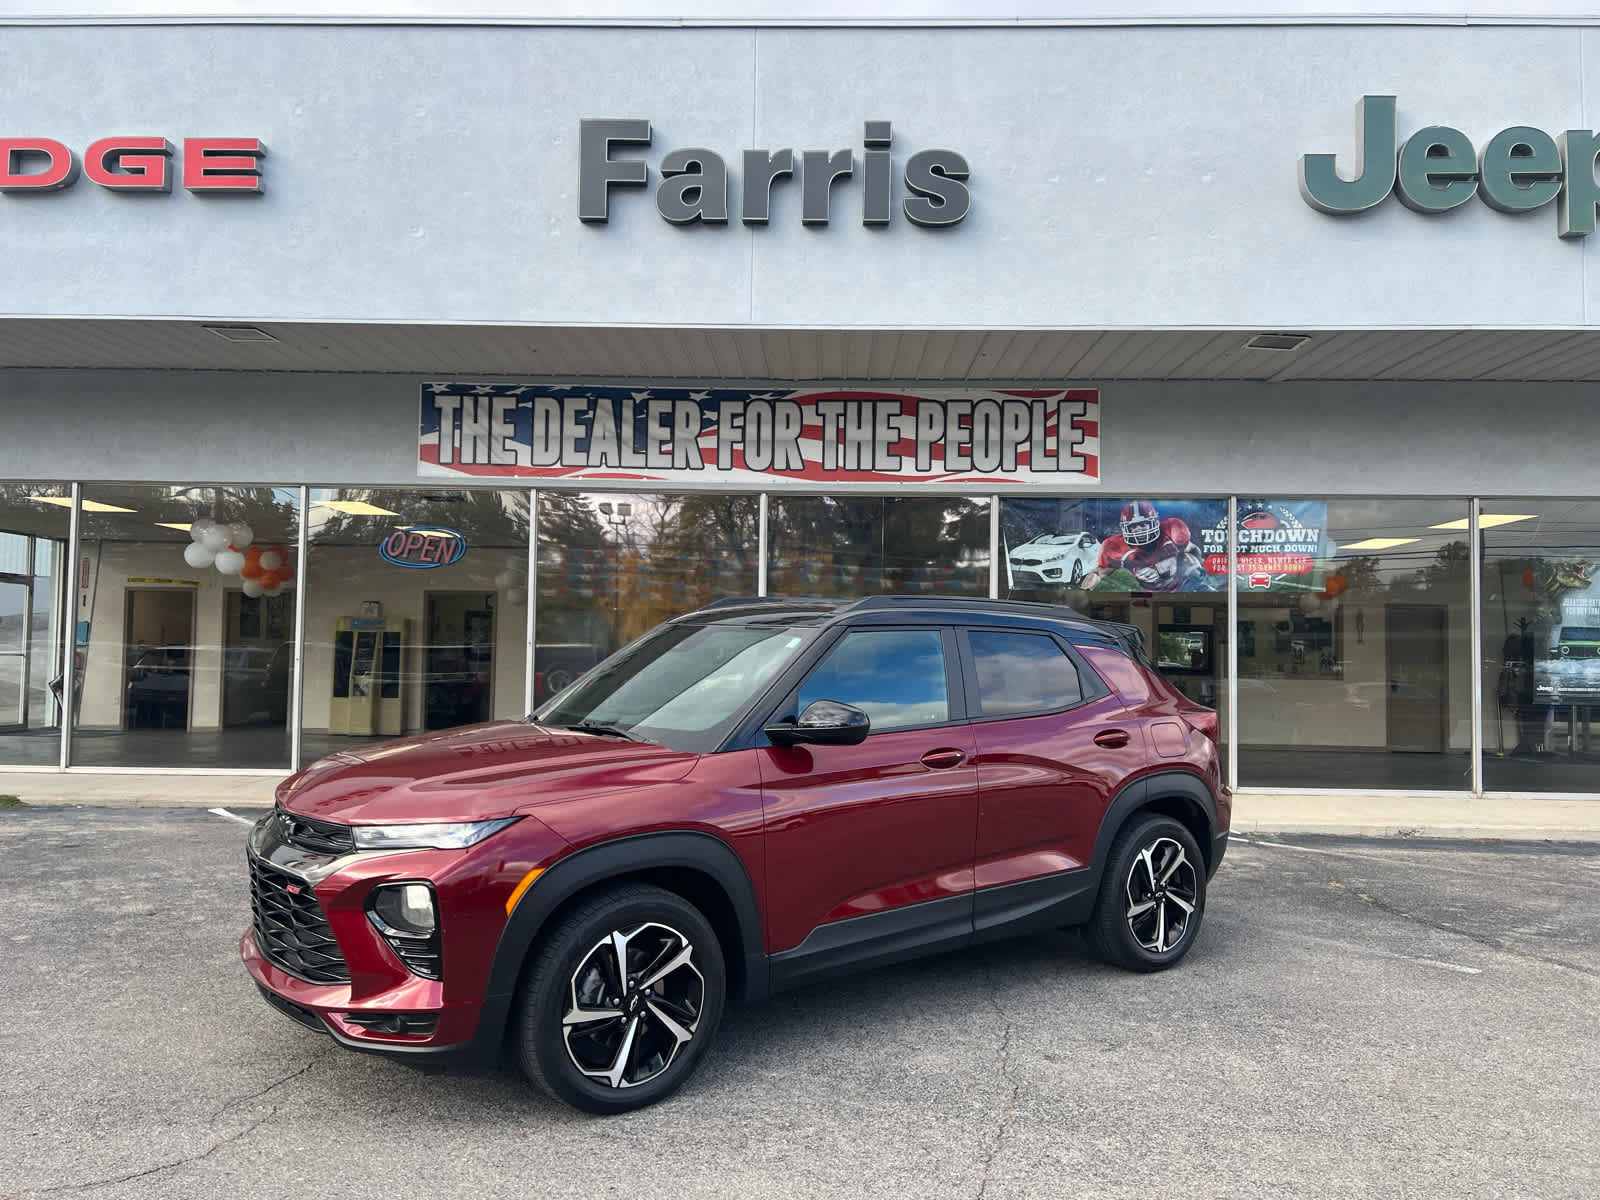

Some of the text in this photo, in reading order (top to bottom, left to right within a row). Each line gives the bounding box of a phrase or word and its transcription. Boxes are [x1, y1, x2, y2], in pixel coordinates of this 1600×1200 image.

[578, 118, 971, 226] Farris
[434, 395, 1087, 473] THE DEALER FOR THE PEOPLE
[387, 531, 457, 564] OPEN
[1201, 528, 1319, 543] TOCHDOWN
[1203, 543, 1318, 553] FOR OT MUCH DOWN!
